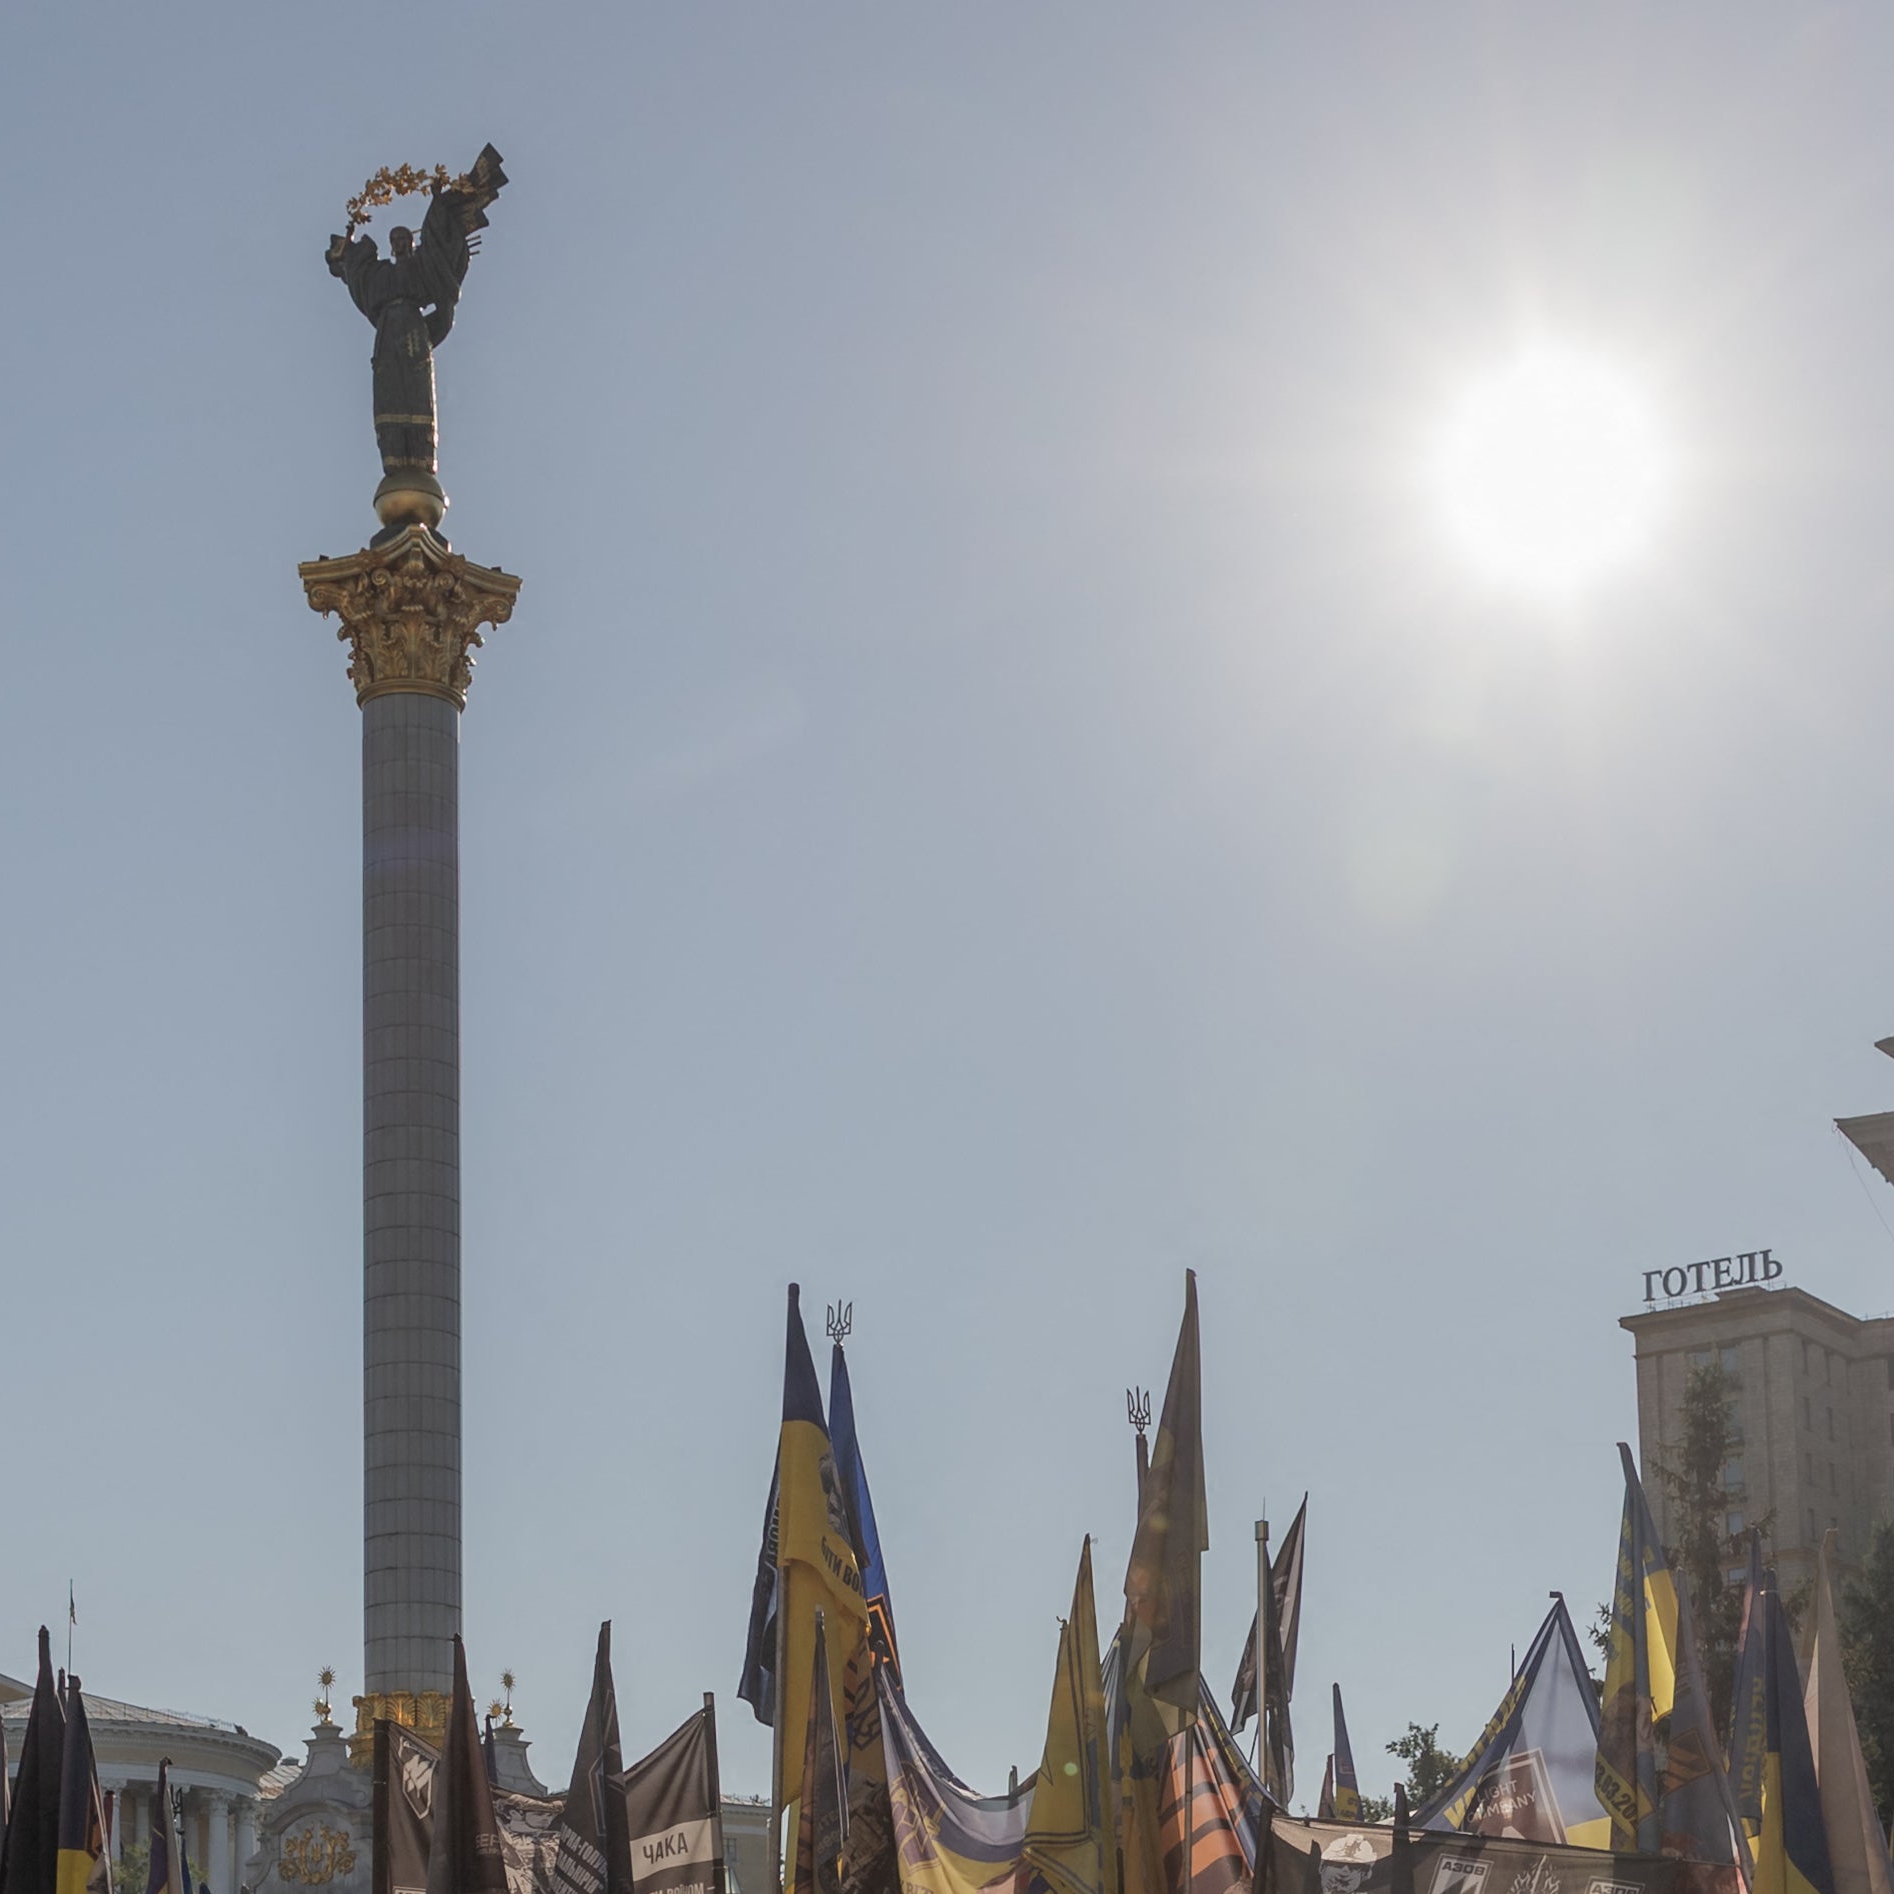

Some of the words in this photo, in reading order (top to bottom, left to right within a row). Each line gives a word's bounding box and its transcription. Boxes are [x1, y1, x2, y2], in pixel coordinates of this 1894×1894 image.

[1642, 1250, 1784, 1301] ГОТЕЛЬ
[643, 1832, 689, 1864] ЧАКА
[1442, 1861, 1486, 1876] АЗОВ
